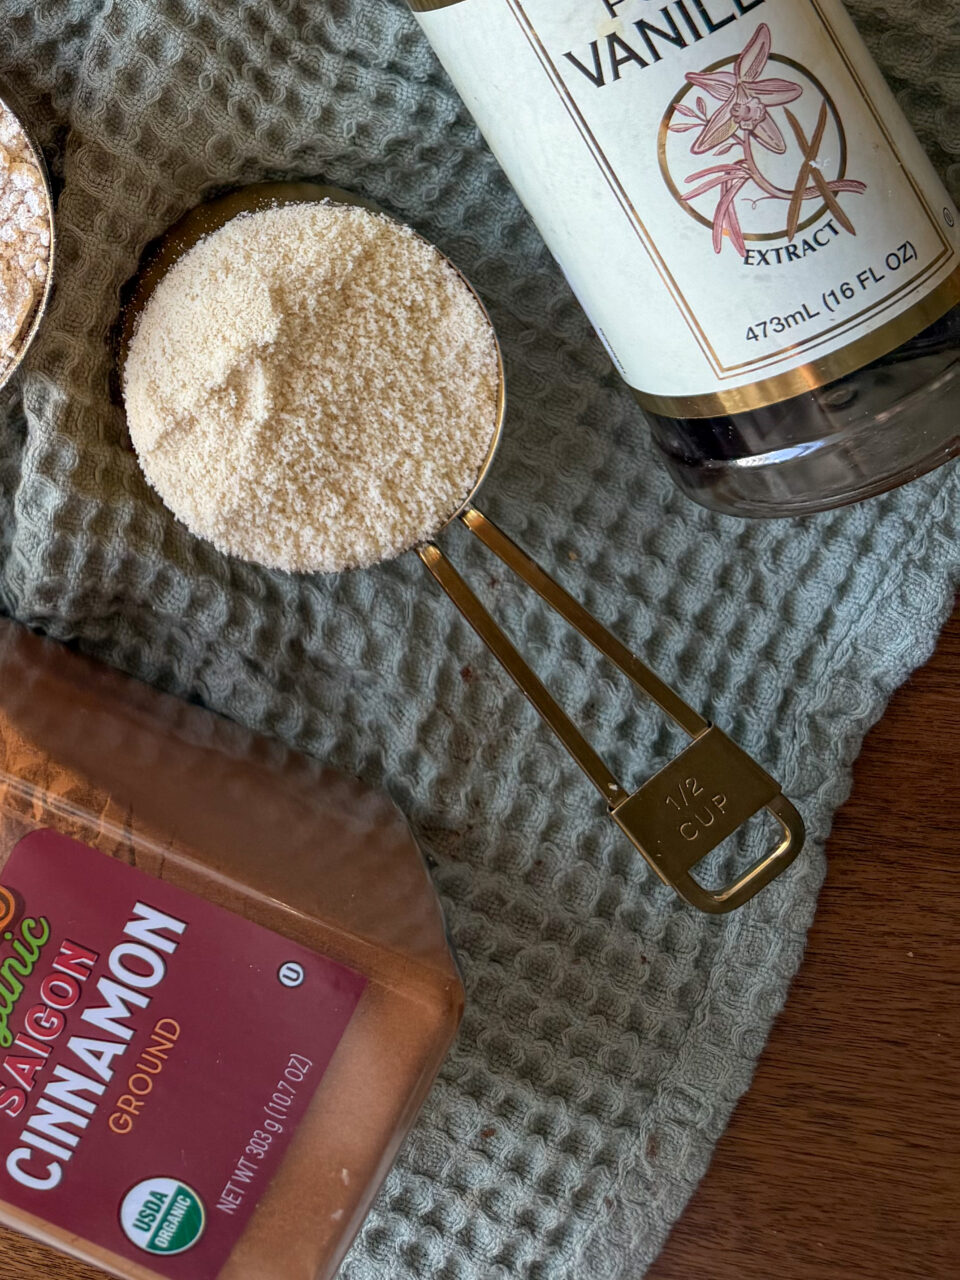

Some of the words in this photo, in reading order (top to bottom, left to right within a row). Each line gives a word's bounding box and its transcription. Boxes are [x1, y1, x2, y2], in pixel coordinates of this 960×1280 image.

[743, 218, 840, 266] EXTRACT
[745, 303, 820, 342] 473mL
[822, 282, 855, 312] (16
[856, 267, 886, 290] FL
[885, 240, 918, 271] OZ)
[665, 777, 705, 811] 1/2
[680, 793, 728, 841] CUP
[5, 900, 188, 1191] CINNAMON
[285, 1052, 313, 1084] OZ)
[109, 1018, 181, 1135] GROUND
[263, 1080, 297, 1127] (10.7
[245, 1128, 274, 1161] 303
[264, 1119, 283, 1135] g
[238, 1155, 259, 1189] WT
[132, 1189, 169, 1235] USDA
[154, 1194, 192, 1249] ORGANIC
[215, 1181, 245, 1217] NET
